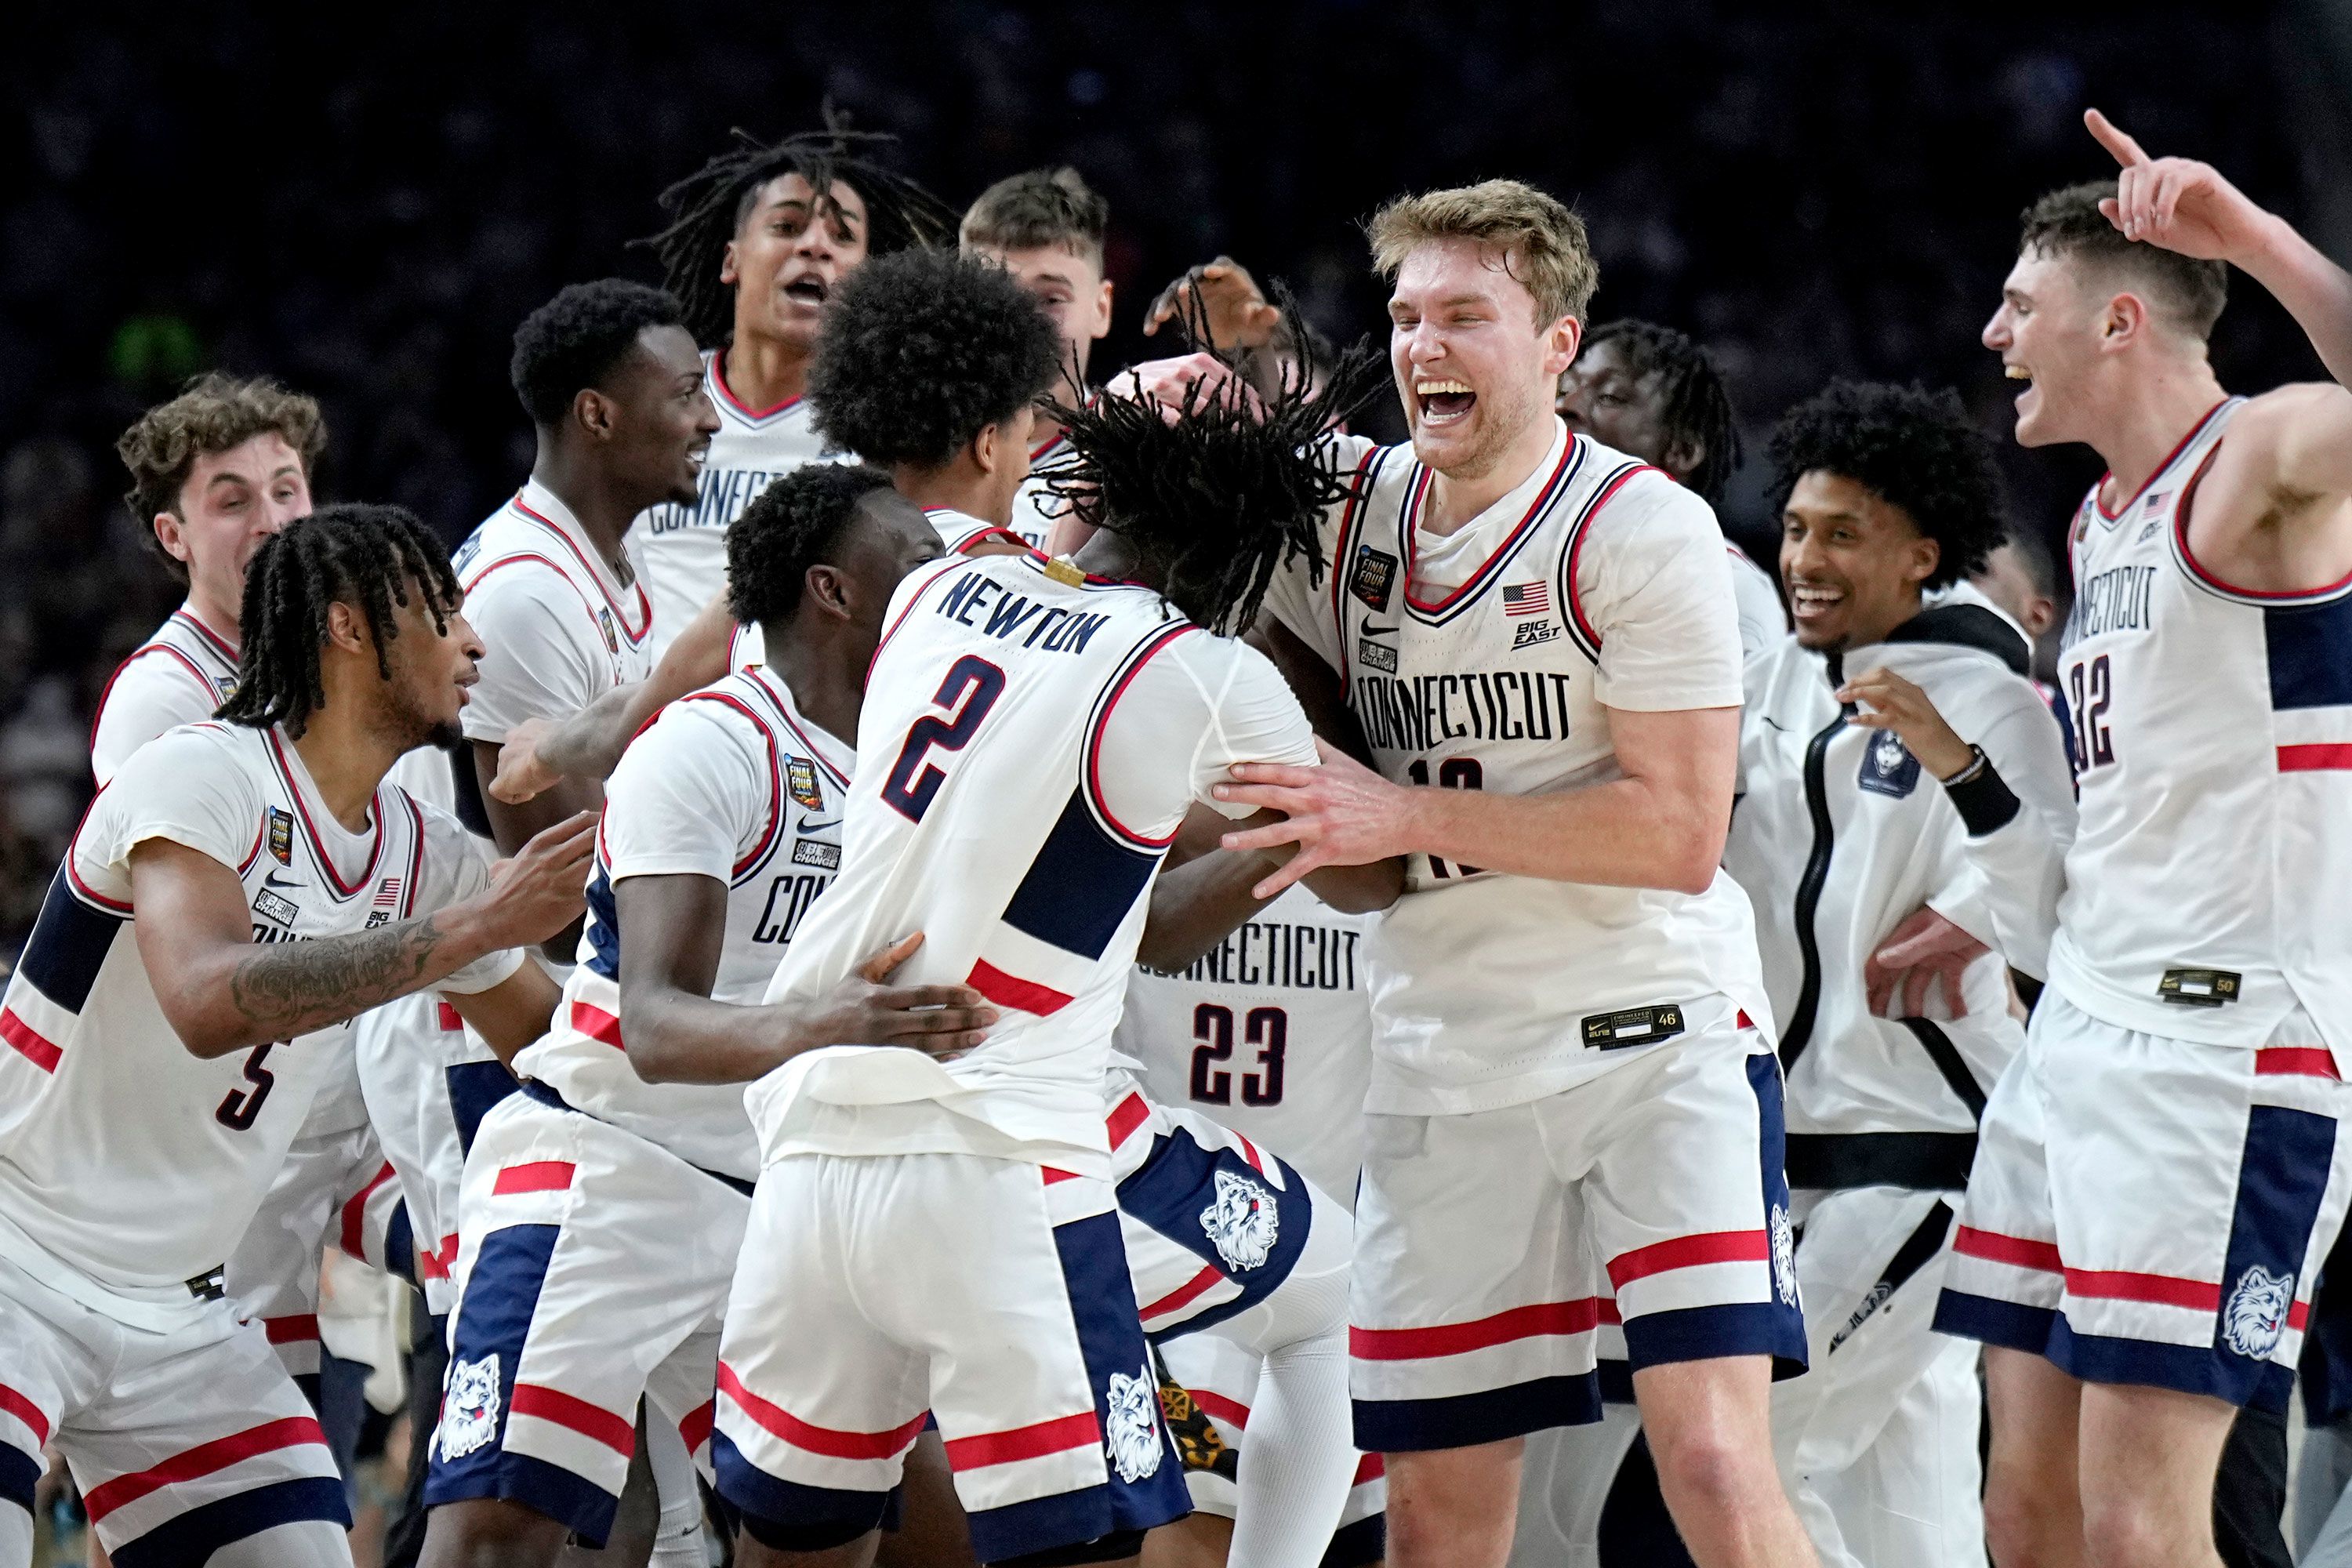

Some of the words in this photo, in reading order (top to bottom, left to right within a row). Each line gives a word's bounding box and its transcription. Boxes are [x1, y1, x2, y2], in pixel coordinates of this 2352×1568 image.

[1361, 558, 1388, 575] FINAL
[1358, 570, 1385, 587] FOUR
[936, 572, 1111, 655] NEWTON
[1514, 626, 1562, 644] EAST
[1516, 619, 1549, 634] BIG
[1368, 644, 1385, 659] BE
[1360, 654, 1396, 672] CHANGE
[1357, 672, 1570, 751] CONNECTICUT
[2071, 654, 2115, 772] 32
[880, 654, 1006, 826] 2
[789, 765, 811, 779] FINAL
[791, 776, 813, 790] FOUR
[273, 818, 289, 833] FINAL
[271, 829, 288, 844] FOUR
[805, 842, 826, 856] BE
[794, 853, 838, 868] CHANGE
[267, 894, 285, 911] BE
[255, 901, 293, 926] CHANGE
[368, 911, 390, 922] BIG
[1658, 1013, 1676, 1025] 46
[1189, 1003, 1287, 1107] 23
